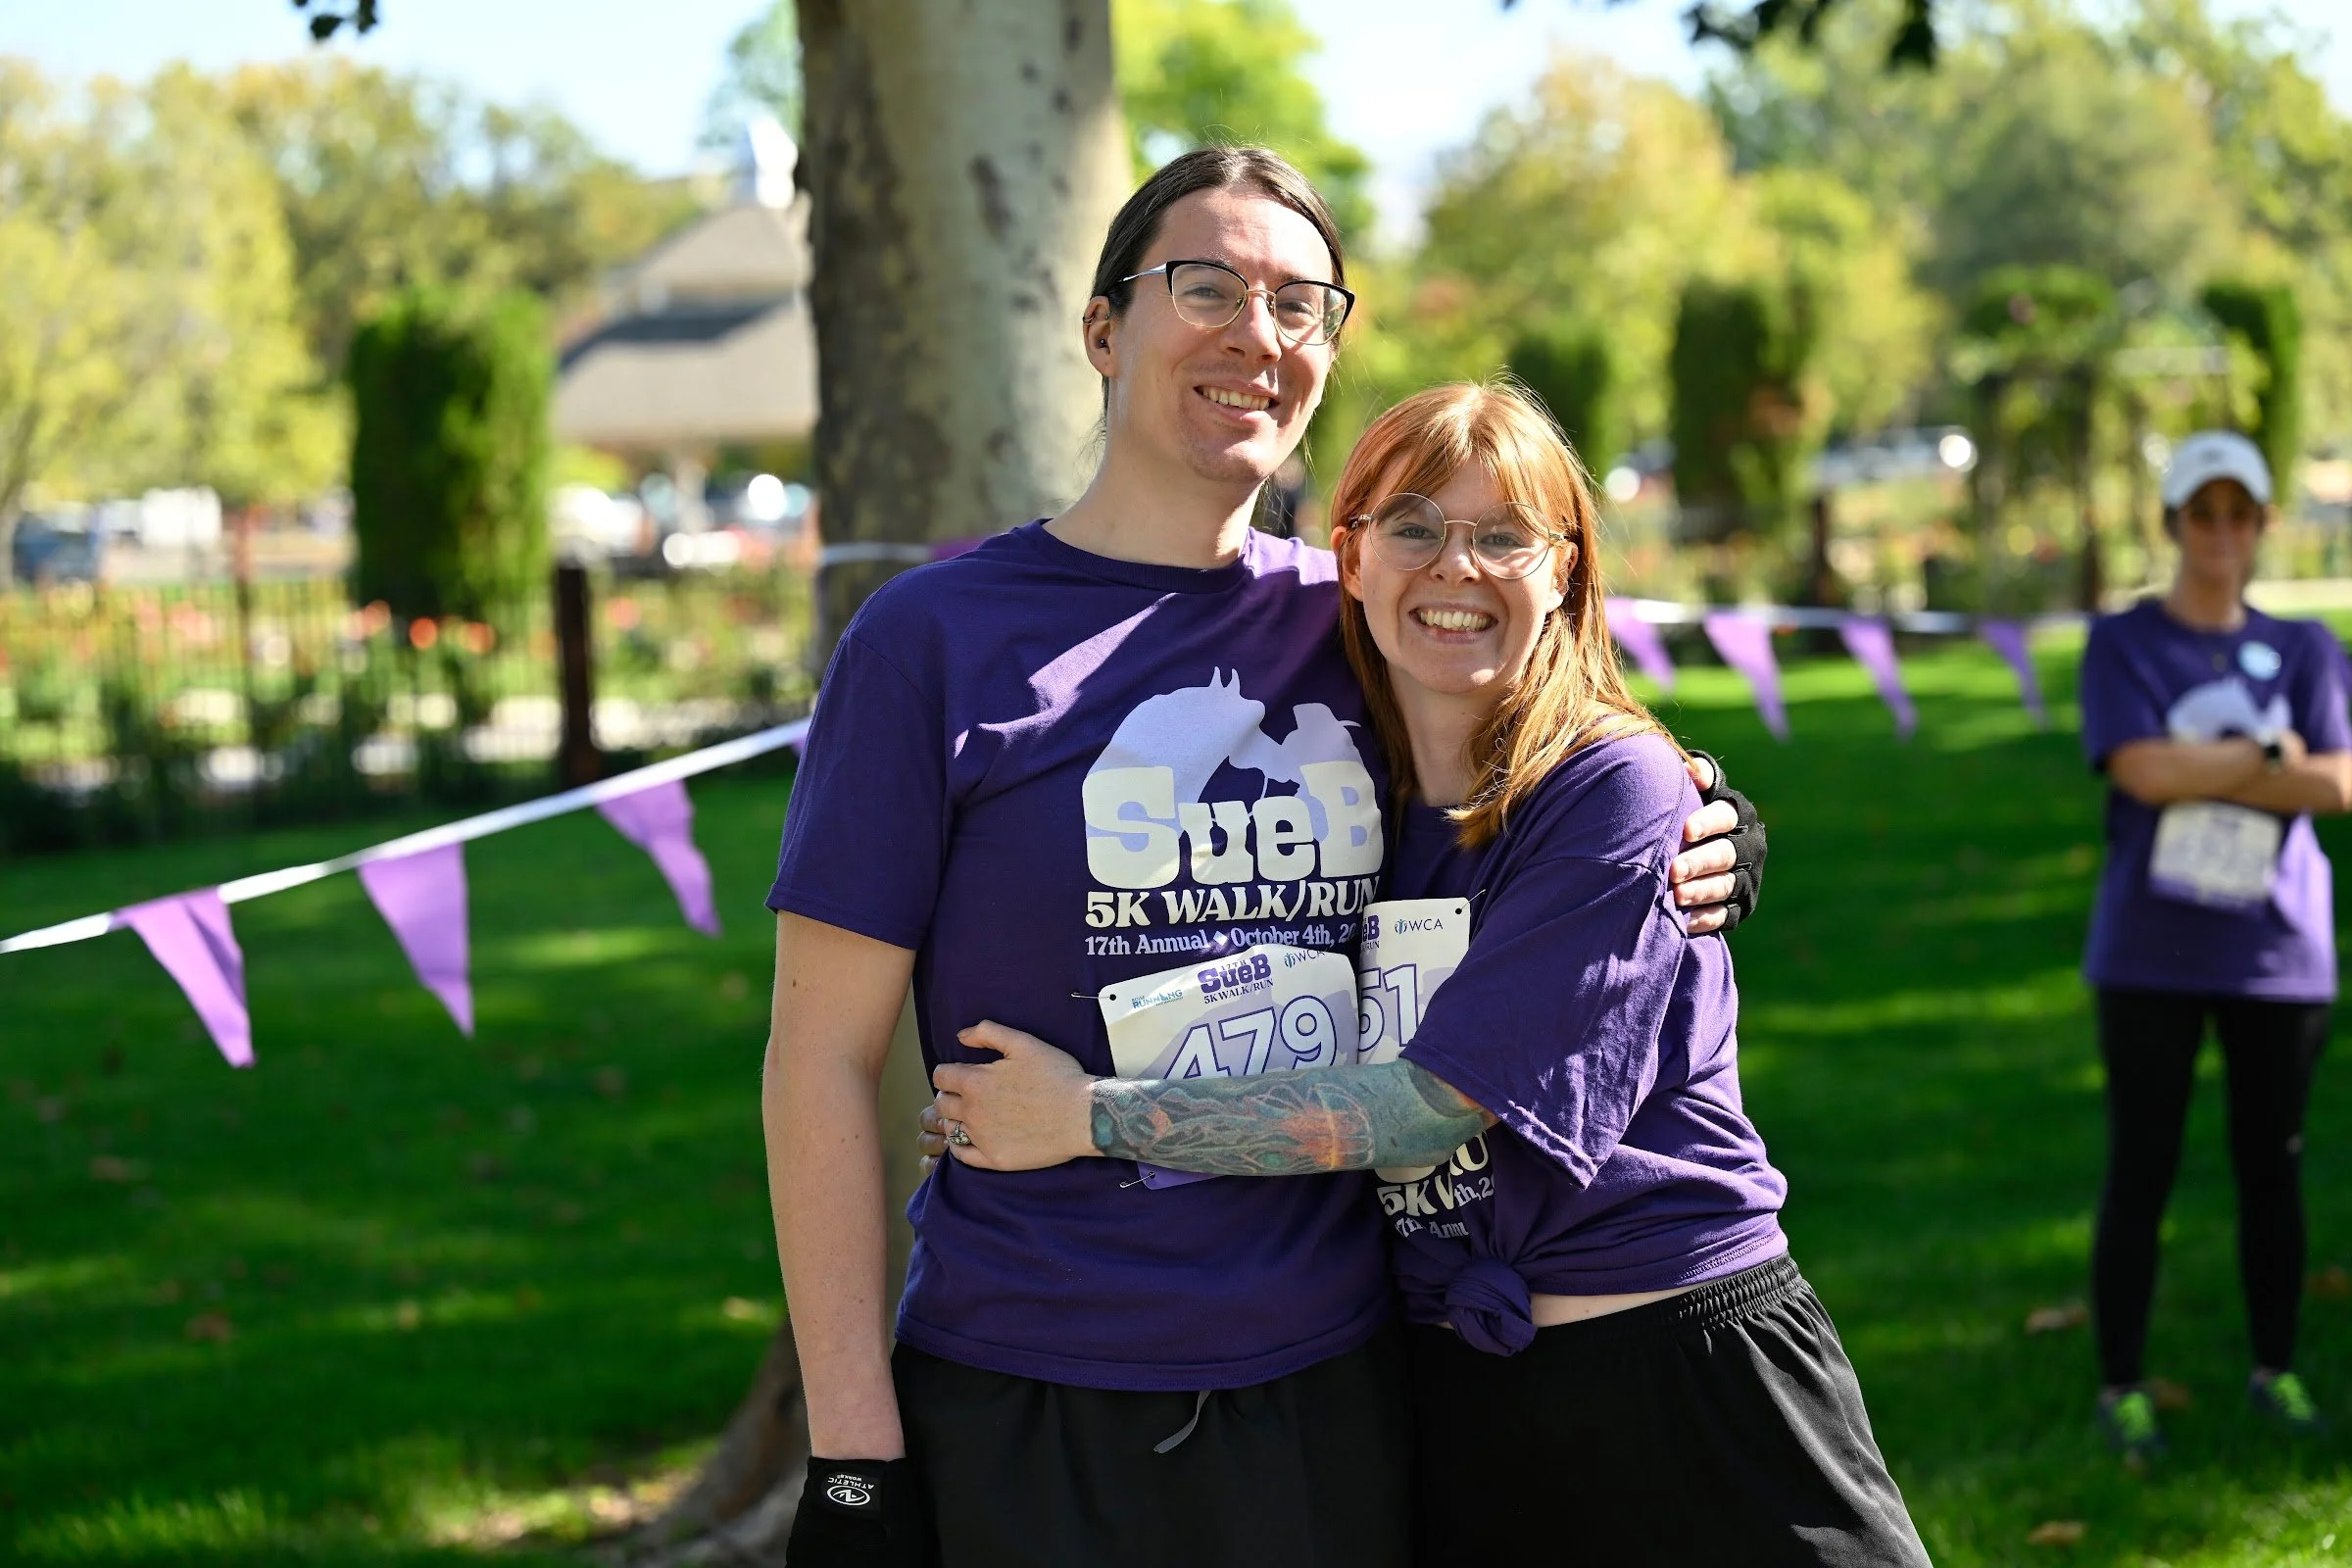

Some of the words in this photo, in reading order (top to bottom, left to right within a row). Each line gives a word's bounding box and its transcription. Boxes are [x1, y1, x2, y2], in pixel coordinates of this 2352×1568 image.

[1082, 760, 1384, 889] SueB
[1084, 890, 1152, 927] 5K
[1160, 876, 1381, 924] WALK/RUN
[1084, 935, 1131, 956] 17th
[1135, 930, 1209, 956] Annual
[1230, 925, 1300, 947] October
[1301, 923, 1335, 948] 4th,
[1409, 918, 1444, 932] WCA
[1197, 953, 1272, 994] SueB
[1203, 994, 1218, 1004] 5K
[1218, 978, 1274, 1001] WALK/RUN
[1164, 995, 1337, 1079] 479
[1376, 1179, 1439, 1217] 5K
[827, 1477, 874, 1490] ATHLETIC
